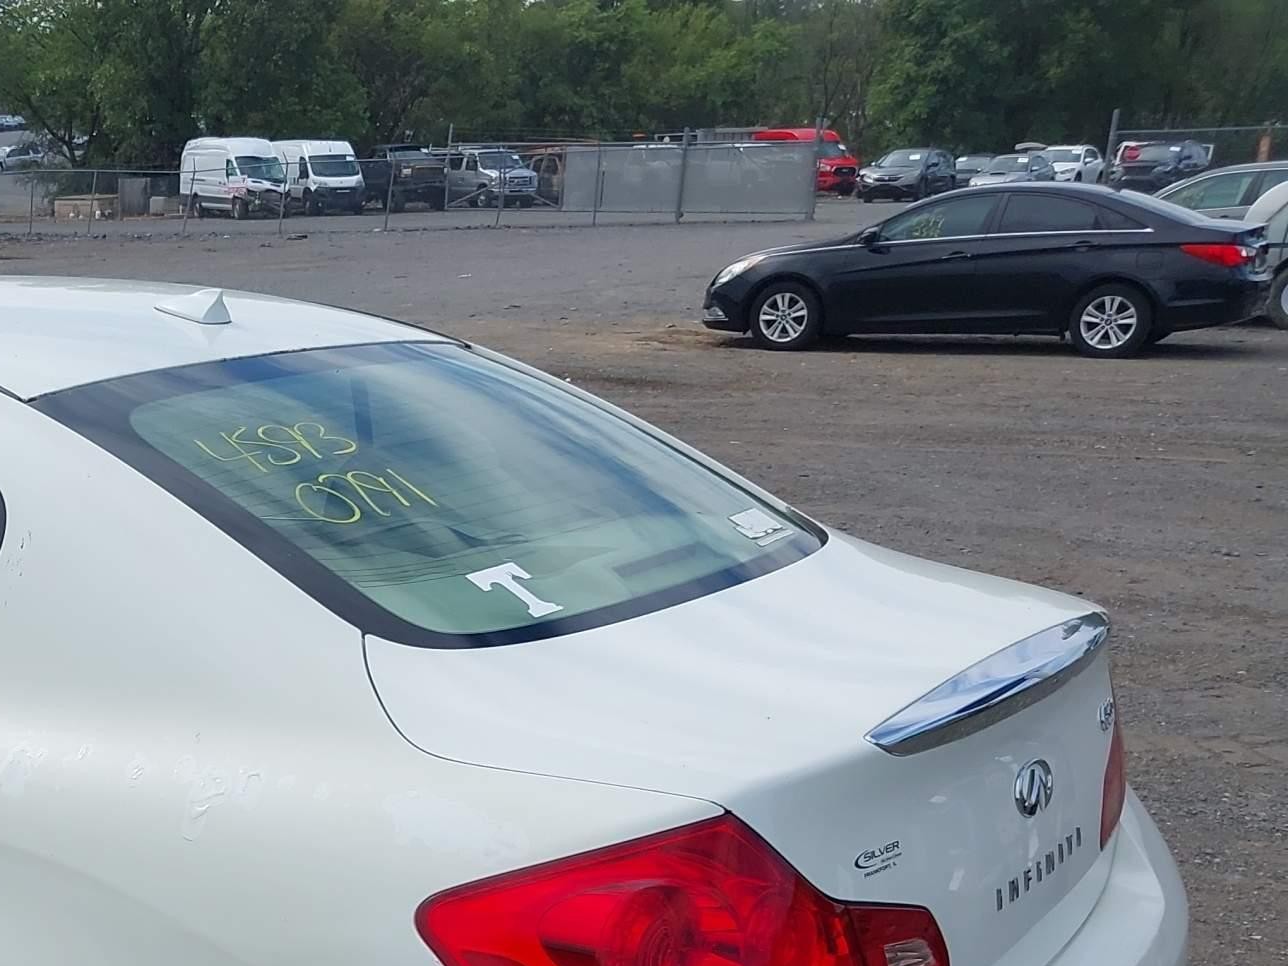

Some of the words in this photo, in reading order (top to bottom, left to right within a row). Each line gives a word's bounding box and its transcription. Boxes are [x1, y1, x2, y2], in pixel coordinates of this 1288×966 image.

[193, 421, 357, 473] 4593
[295, 468, 439, 524] 0791
[864, 840, 900, 863] SILVER
[996, 827, 1082, 912] INFINITI
